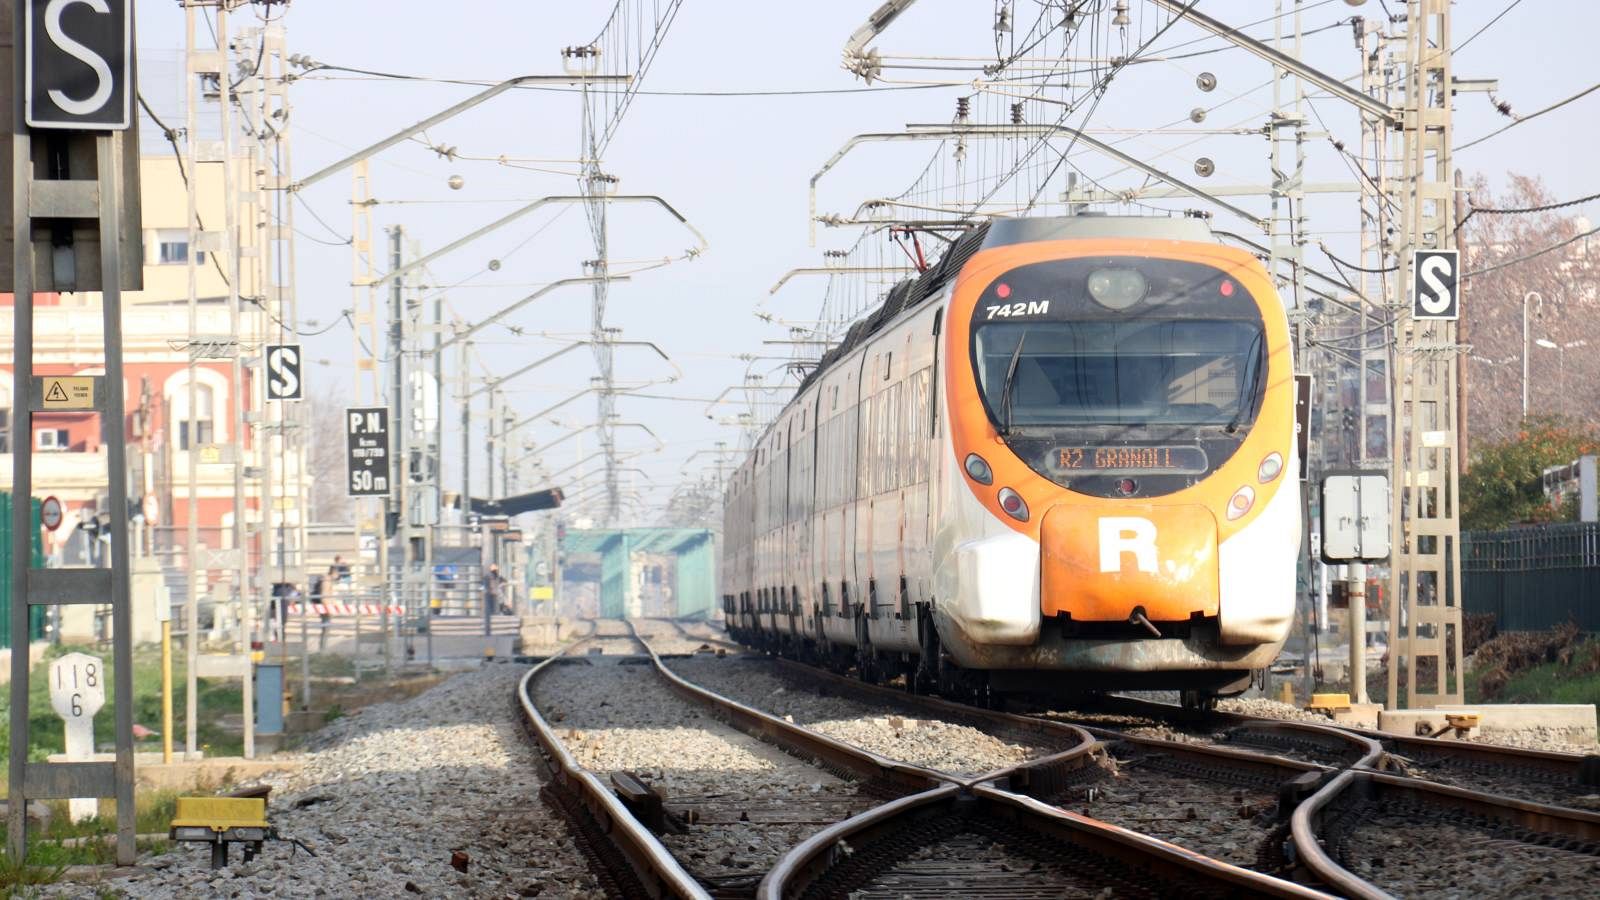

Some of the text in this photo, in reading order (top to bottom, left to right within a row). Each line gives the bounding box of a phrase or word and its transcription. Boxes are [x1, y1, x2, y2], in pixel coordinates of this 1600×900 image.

[44, 0, 113, 115] S
[1420, 255, 1452, 314] S
[986, 299, 1050, 320] 742M
[269, 347, 298, 397] S
[350, 412, 386, 434] P.N.
[1060, 447, 1083, 468] R2
[352, 469, 387, 491] 50 m
[1097, 516, 1160, 573] R
[57, 663, 97, 690] 118
[71, 693, 82, 717] 6
